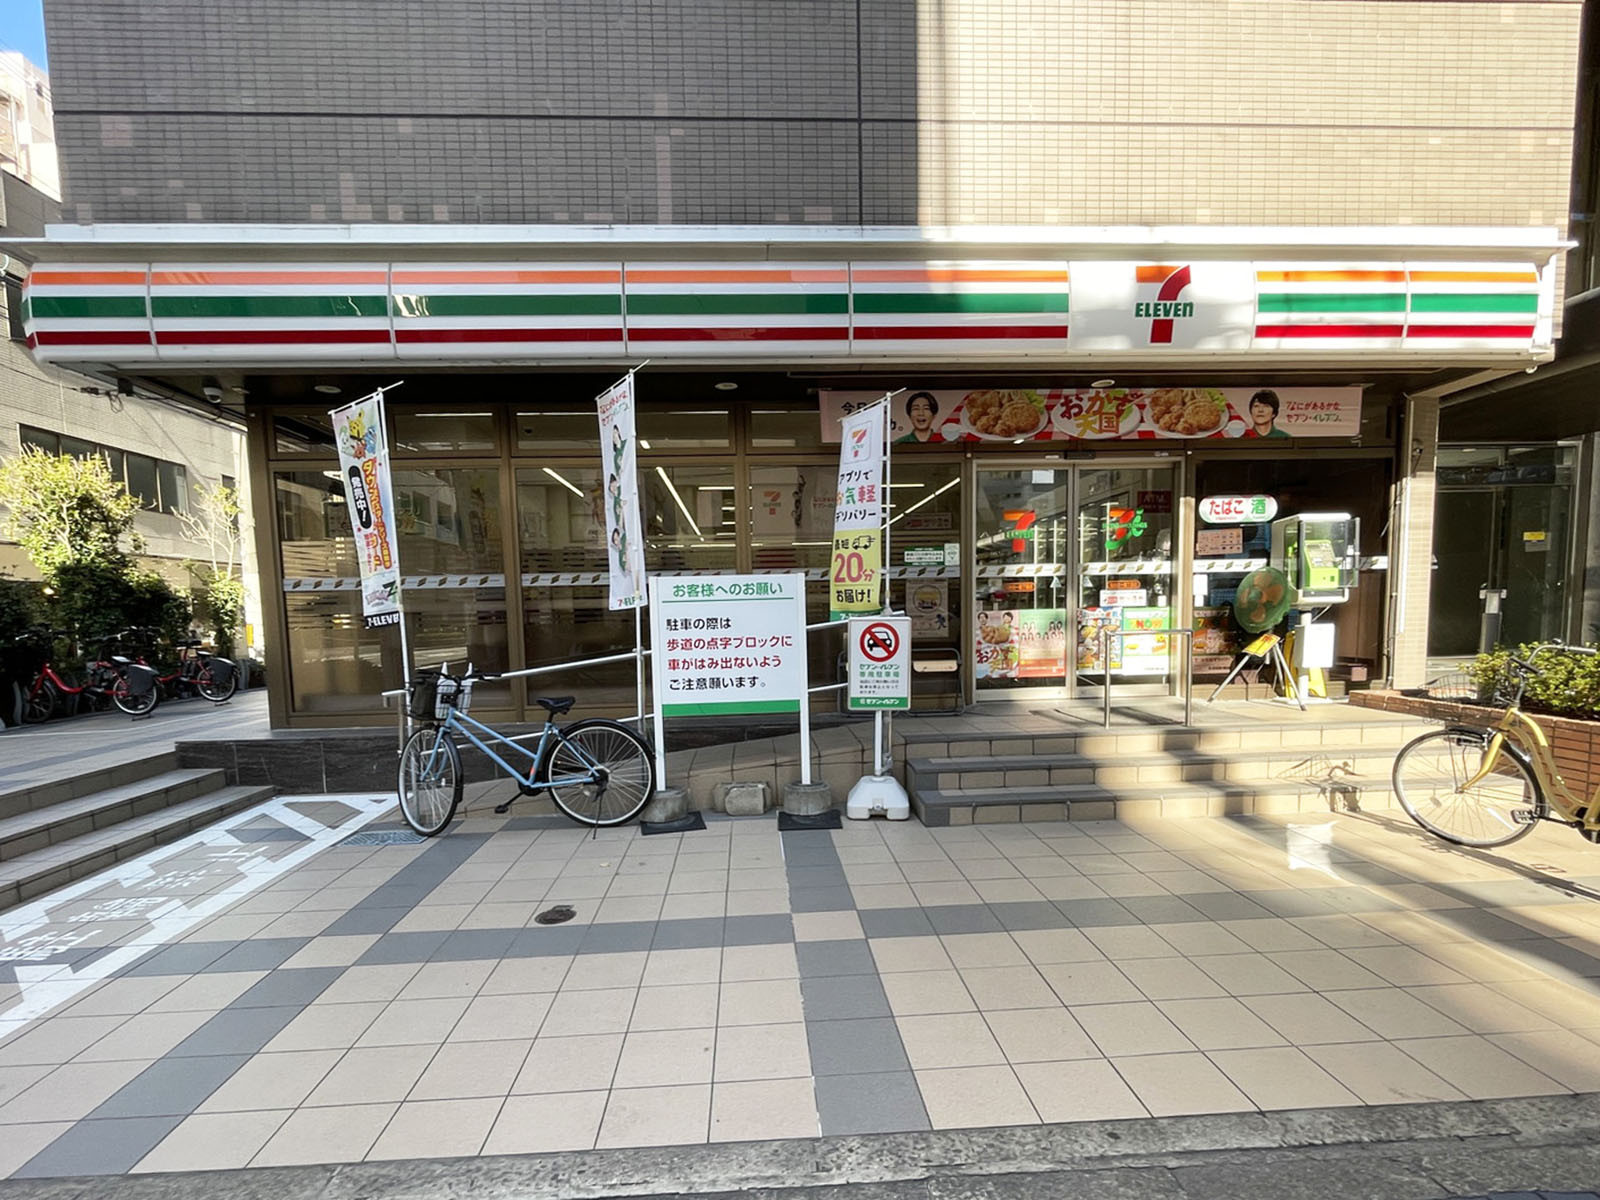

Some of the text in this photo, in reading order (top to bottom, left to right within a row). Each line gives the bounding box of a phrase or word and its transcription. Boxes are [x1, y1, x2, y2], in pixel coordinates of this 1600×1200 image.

[1073, 412, 1119, 437] 天国
[1209, 499, 1244, 516] たばこ
[1251, 499, 1266, 515] 酒
[673, 582, 783, 598] お客様へのお願い
[836, 589, 871, 603] お届け!
[666, 617, 732, 631] 駐車の際は
[666, 635, 793, 651] 歩道の点字ブロックに
[668, 655, 782, 670] 車がはみ出ないよう
[669, 676, 766, 691] ご注意願います。
